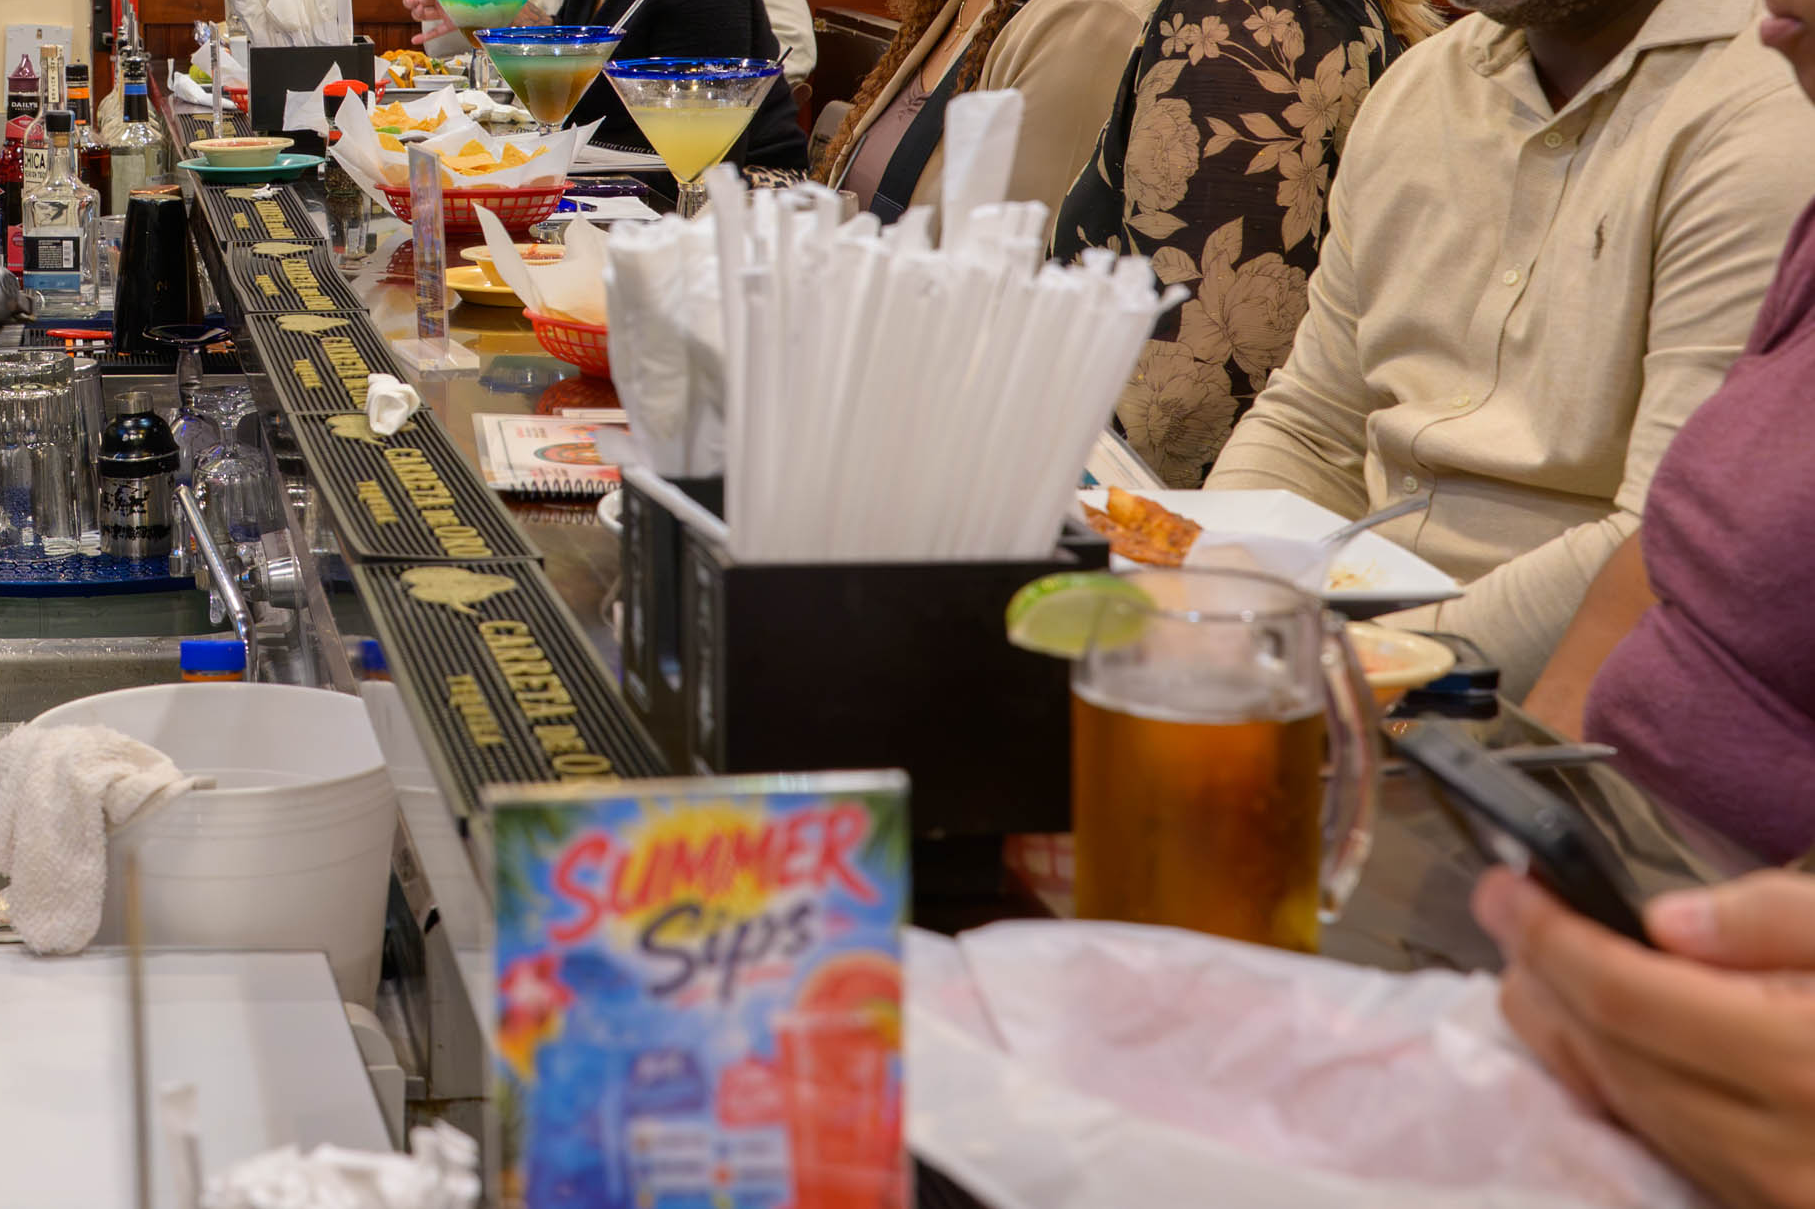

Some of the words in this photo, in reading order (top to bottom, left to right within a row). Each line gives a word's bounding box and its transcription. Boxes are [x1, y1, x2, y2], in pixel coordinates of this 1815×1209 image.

[383, 447, 455, 510] CARRETA
[478, 620, 578, 718] CARRETA
[533, 724, 587, 752] DE
[549, 802, 879, 946] SUMMER
[638, 899, 820, 1006] Sips
